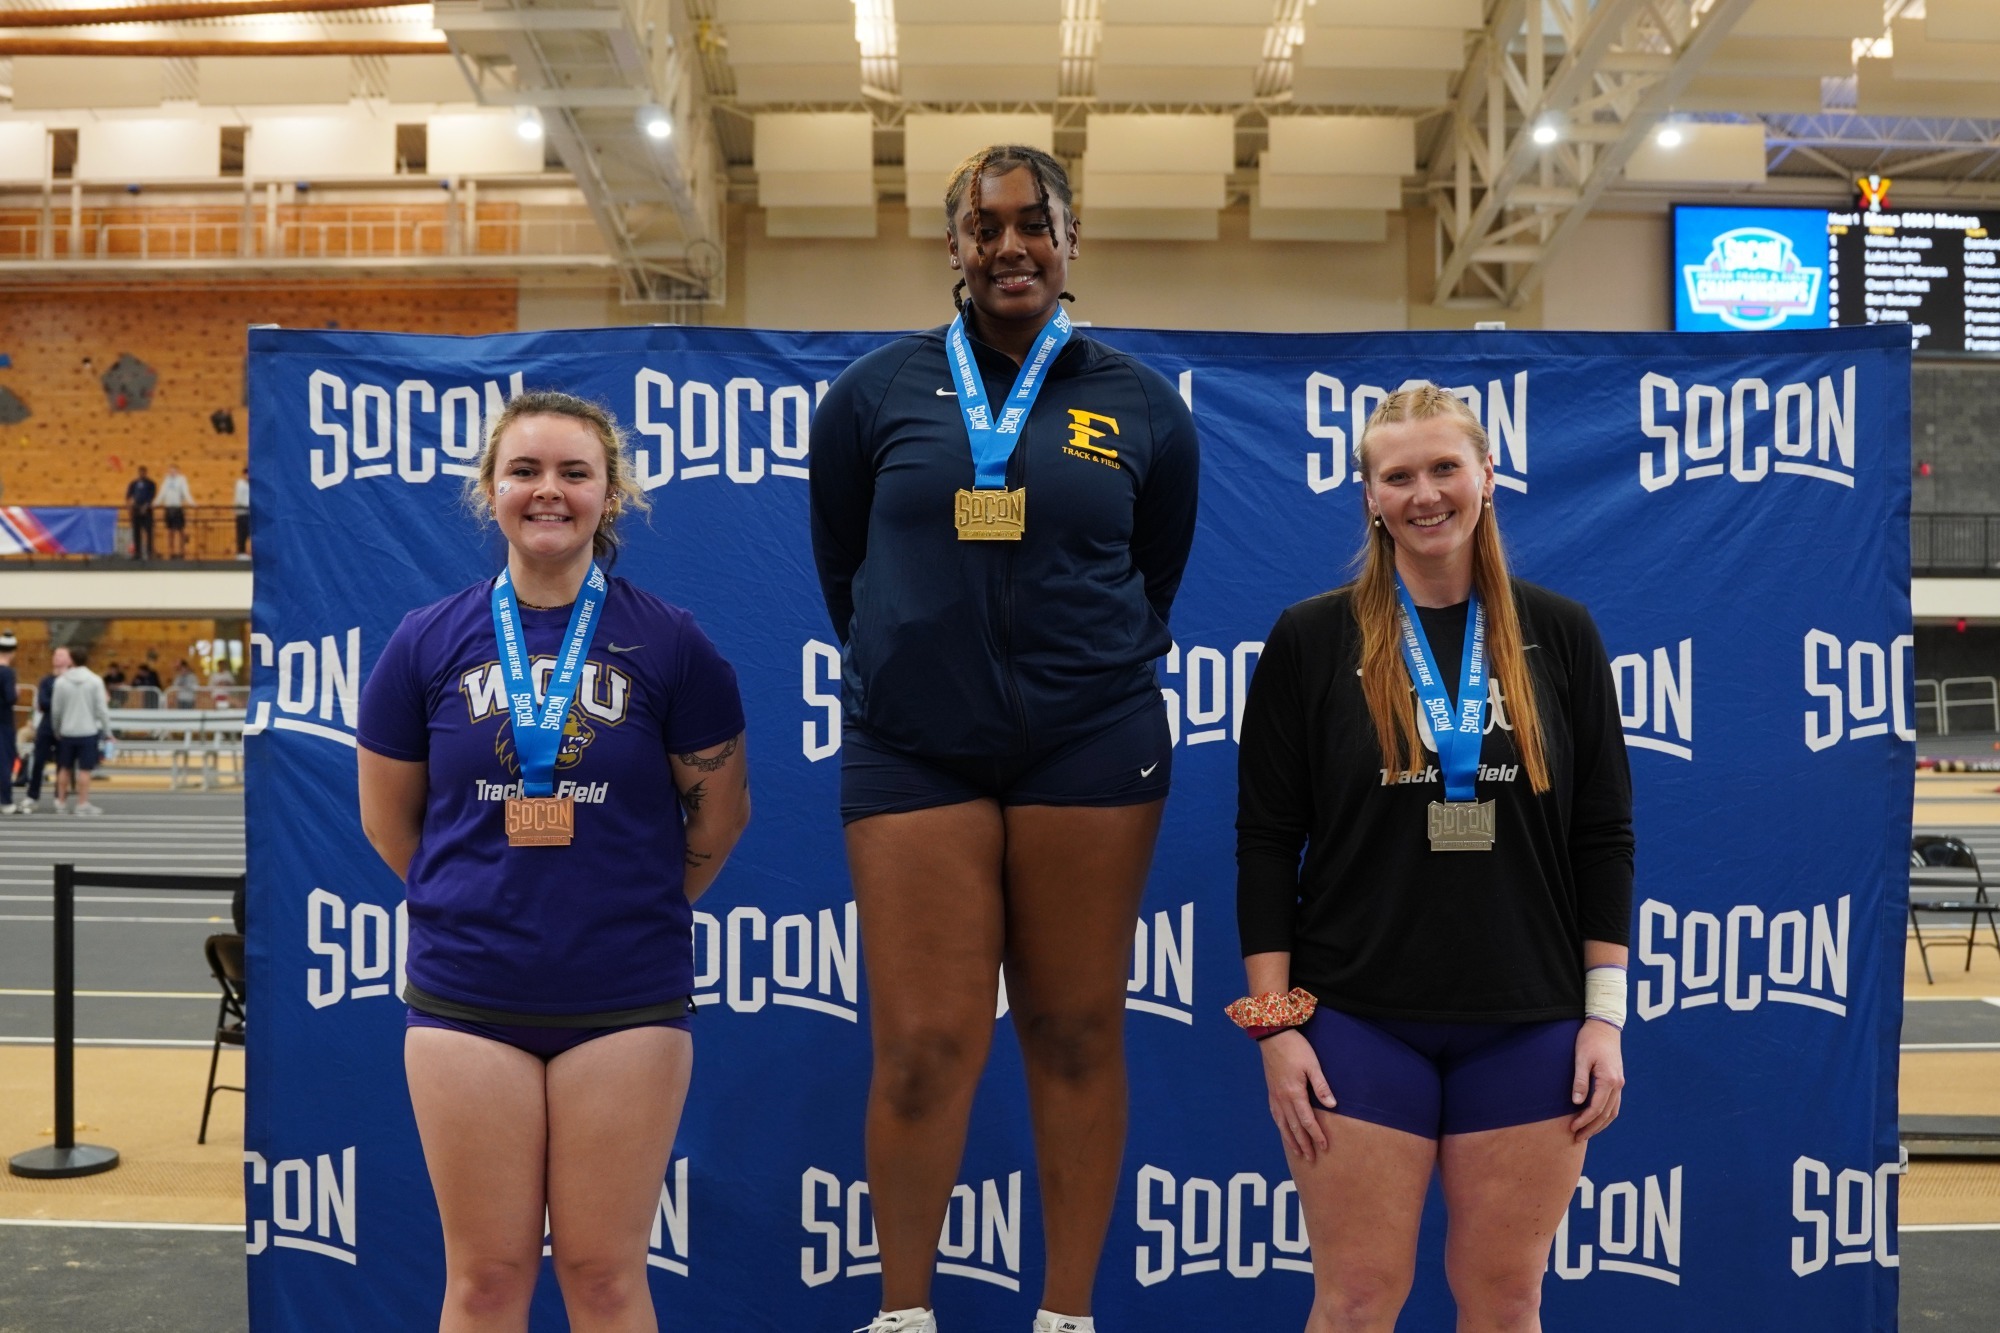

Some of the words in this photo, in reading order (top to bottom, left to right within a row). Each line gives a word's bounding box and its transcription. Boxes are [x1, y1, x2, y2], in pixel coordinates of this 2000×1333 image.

[635, 367, 829, 491] SOCO
[1062, 446, 1090, 460] TRACK
[1092, 455, 1099, 463] &
[1101, 457, 1120, 470] FIELD
[501, 610, 516, 641] SOUTHERN
[575, 599, 595, 638] CONFERENCE
[506, 641, 523, 680] CONFERENCE
[564, 638, 584, 670] SOUTHERN
[1411, 647, 1434, 686] CONFERENCE
[1471, 641, 1483, 674] SOUTHERN
[559, 669, 572, 683] THE
[1469, 673, 1480, 686] THE
[1380, 765, 1439, 786] Tack
[1476, 764, 1519, 782] ield
[476, 779, 526, 801] Track
[556, 780, 609, 803] Field
